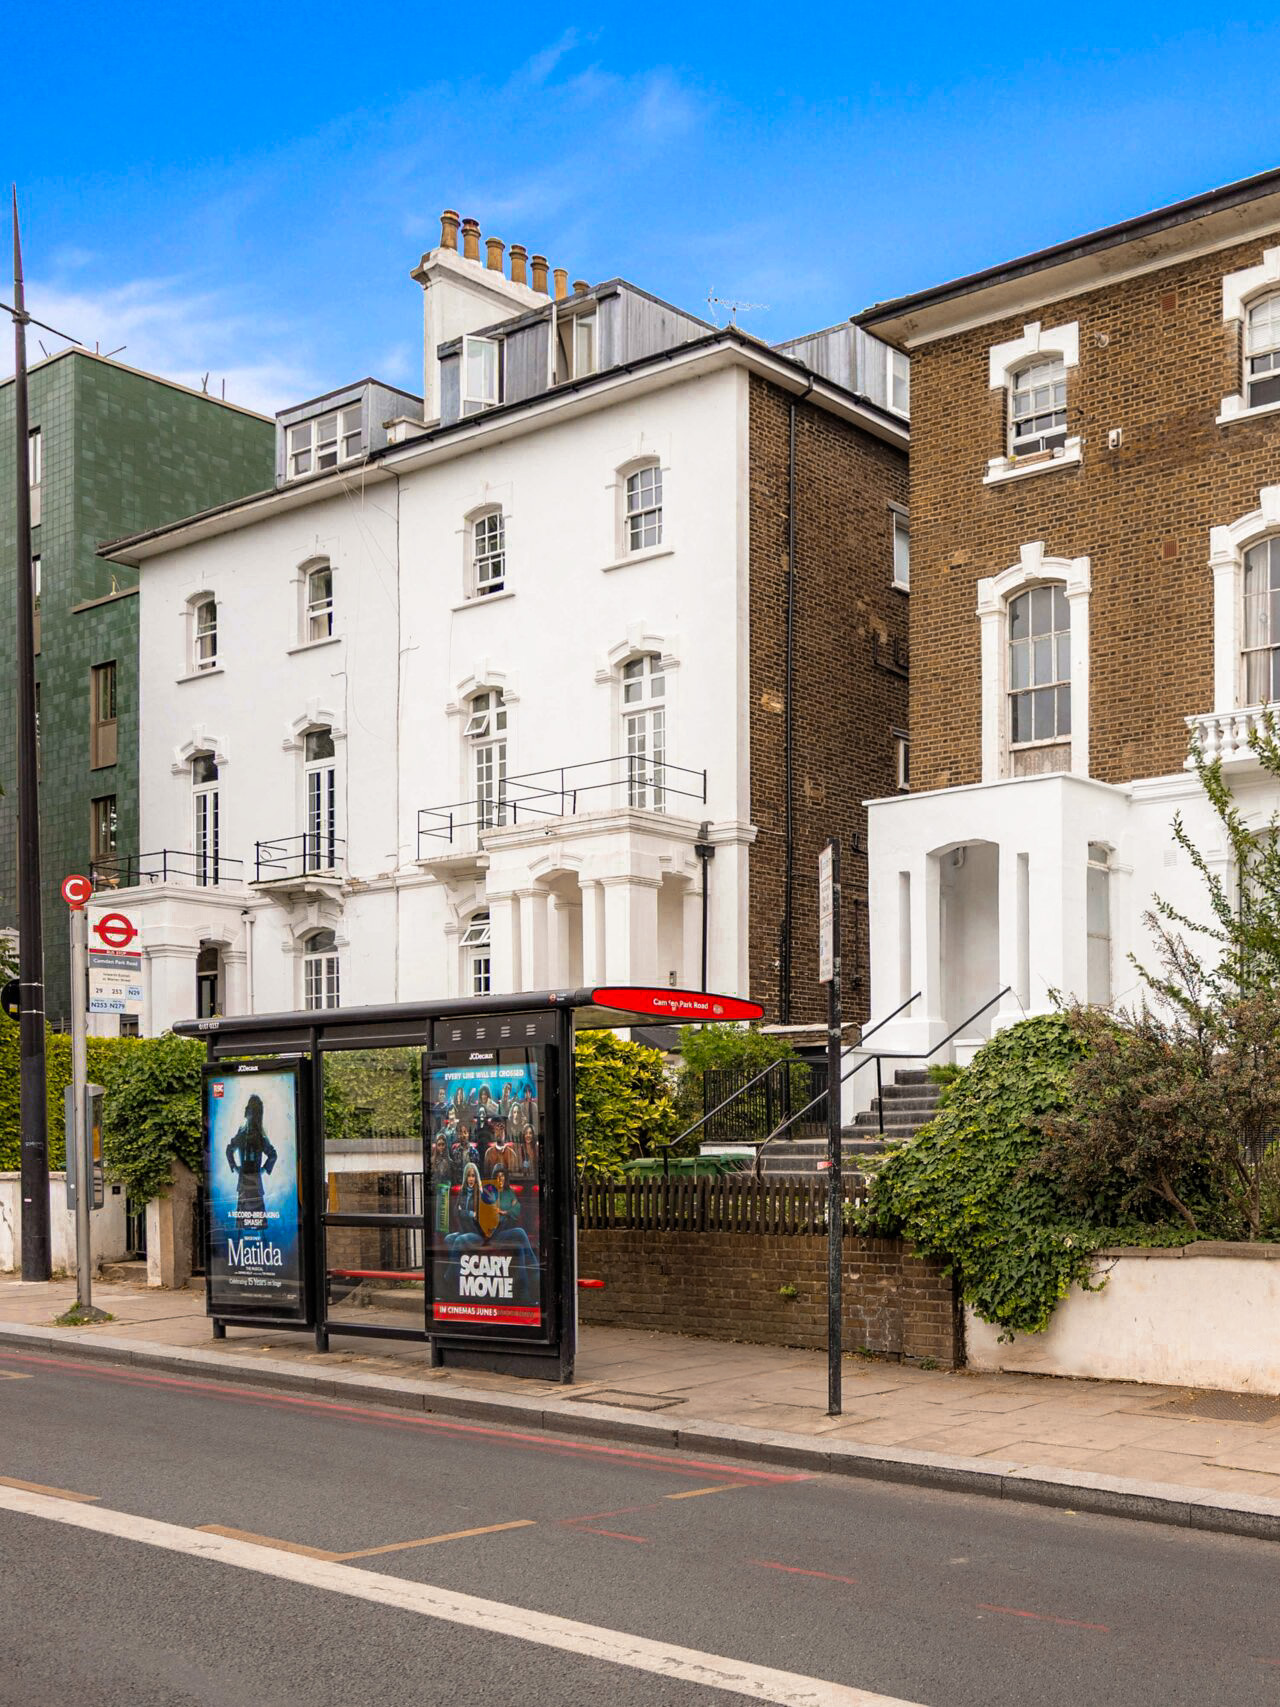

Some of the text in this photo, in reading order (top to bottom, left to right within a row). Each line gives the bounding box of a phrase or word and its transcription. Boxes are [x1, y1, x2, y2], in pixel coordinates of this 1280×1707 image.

[65, 879, 83, 901] C
[679, 1000, 693, 1009] Park
[693, 1002, 709, 1010] Road
[469, 1052, 494, 1060] JCDecaux
[498, 1069, 525, 1077] CROSSED
[227, 1238, 283, 1266] Matilda
[459, 1254, 513, 1277] SCARY
[248, 1277, 254, 1286] 15
[254, 1278, 267, 1286] Years
[459, 1276, 514, 1298] MOVIE
[447, 1306, 476, 1315] CINEMAS
[476, 1308, 491, 1316] JUNE
[492, 1309, 498, 1317] 5
